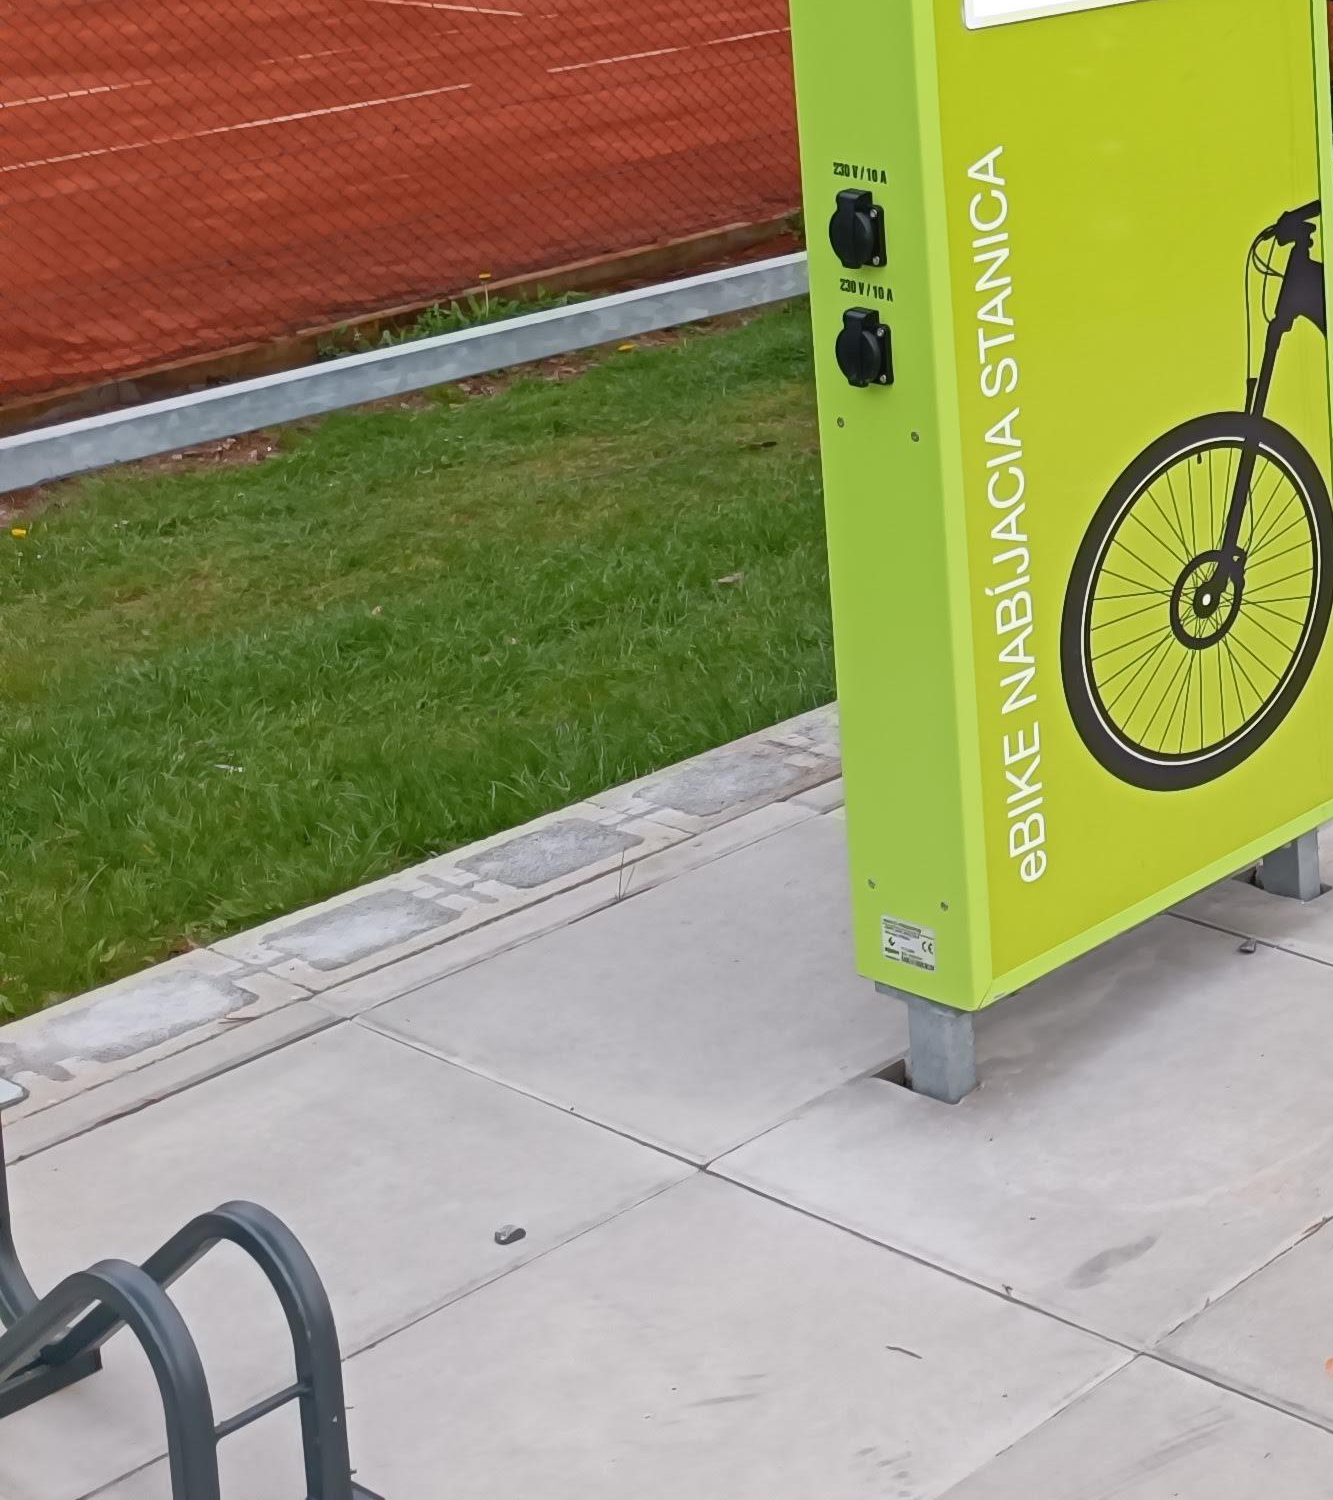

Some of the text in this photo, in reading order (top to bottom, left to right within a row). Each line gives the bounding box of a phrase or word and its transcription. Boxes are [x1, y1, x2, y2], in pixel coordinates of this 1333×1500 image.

[833, 161, 851, 178] 230
[851, 164, 859, 179] V
[866, 167, 878, 183] 10
[880, 170, 887, 185] A
[840, 278, 857, 294] 230
[858, 281, 865, 296] V
[873, 285, 885, 300] 10
[886, 288, 894, 303] A
[967, 145, 1048, 883] eBIKE NABÍJACIA STANICA
